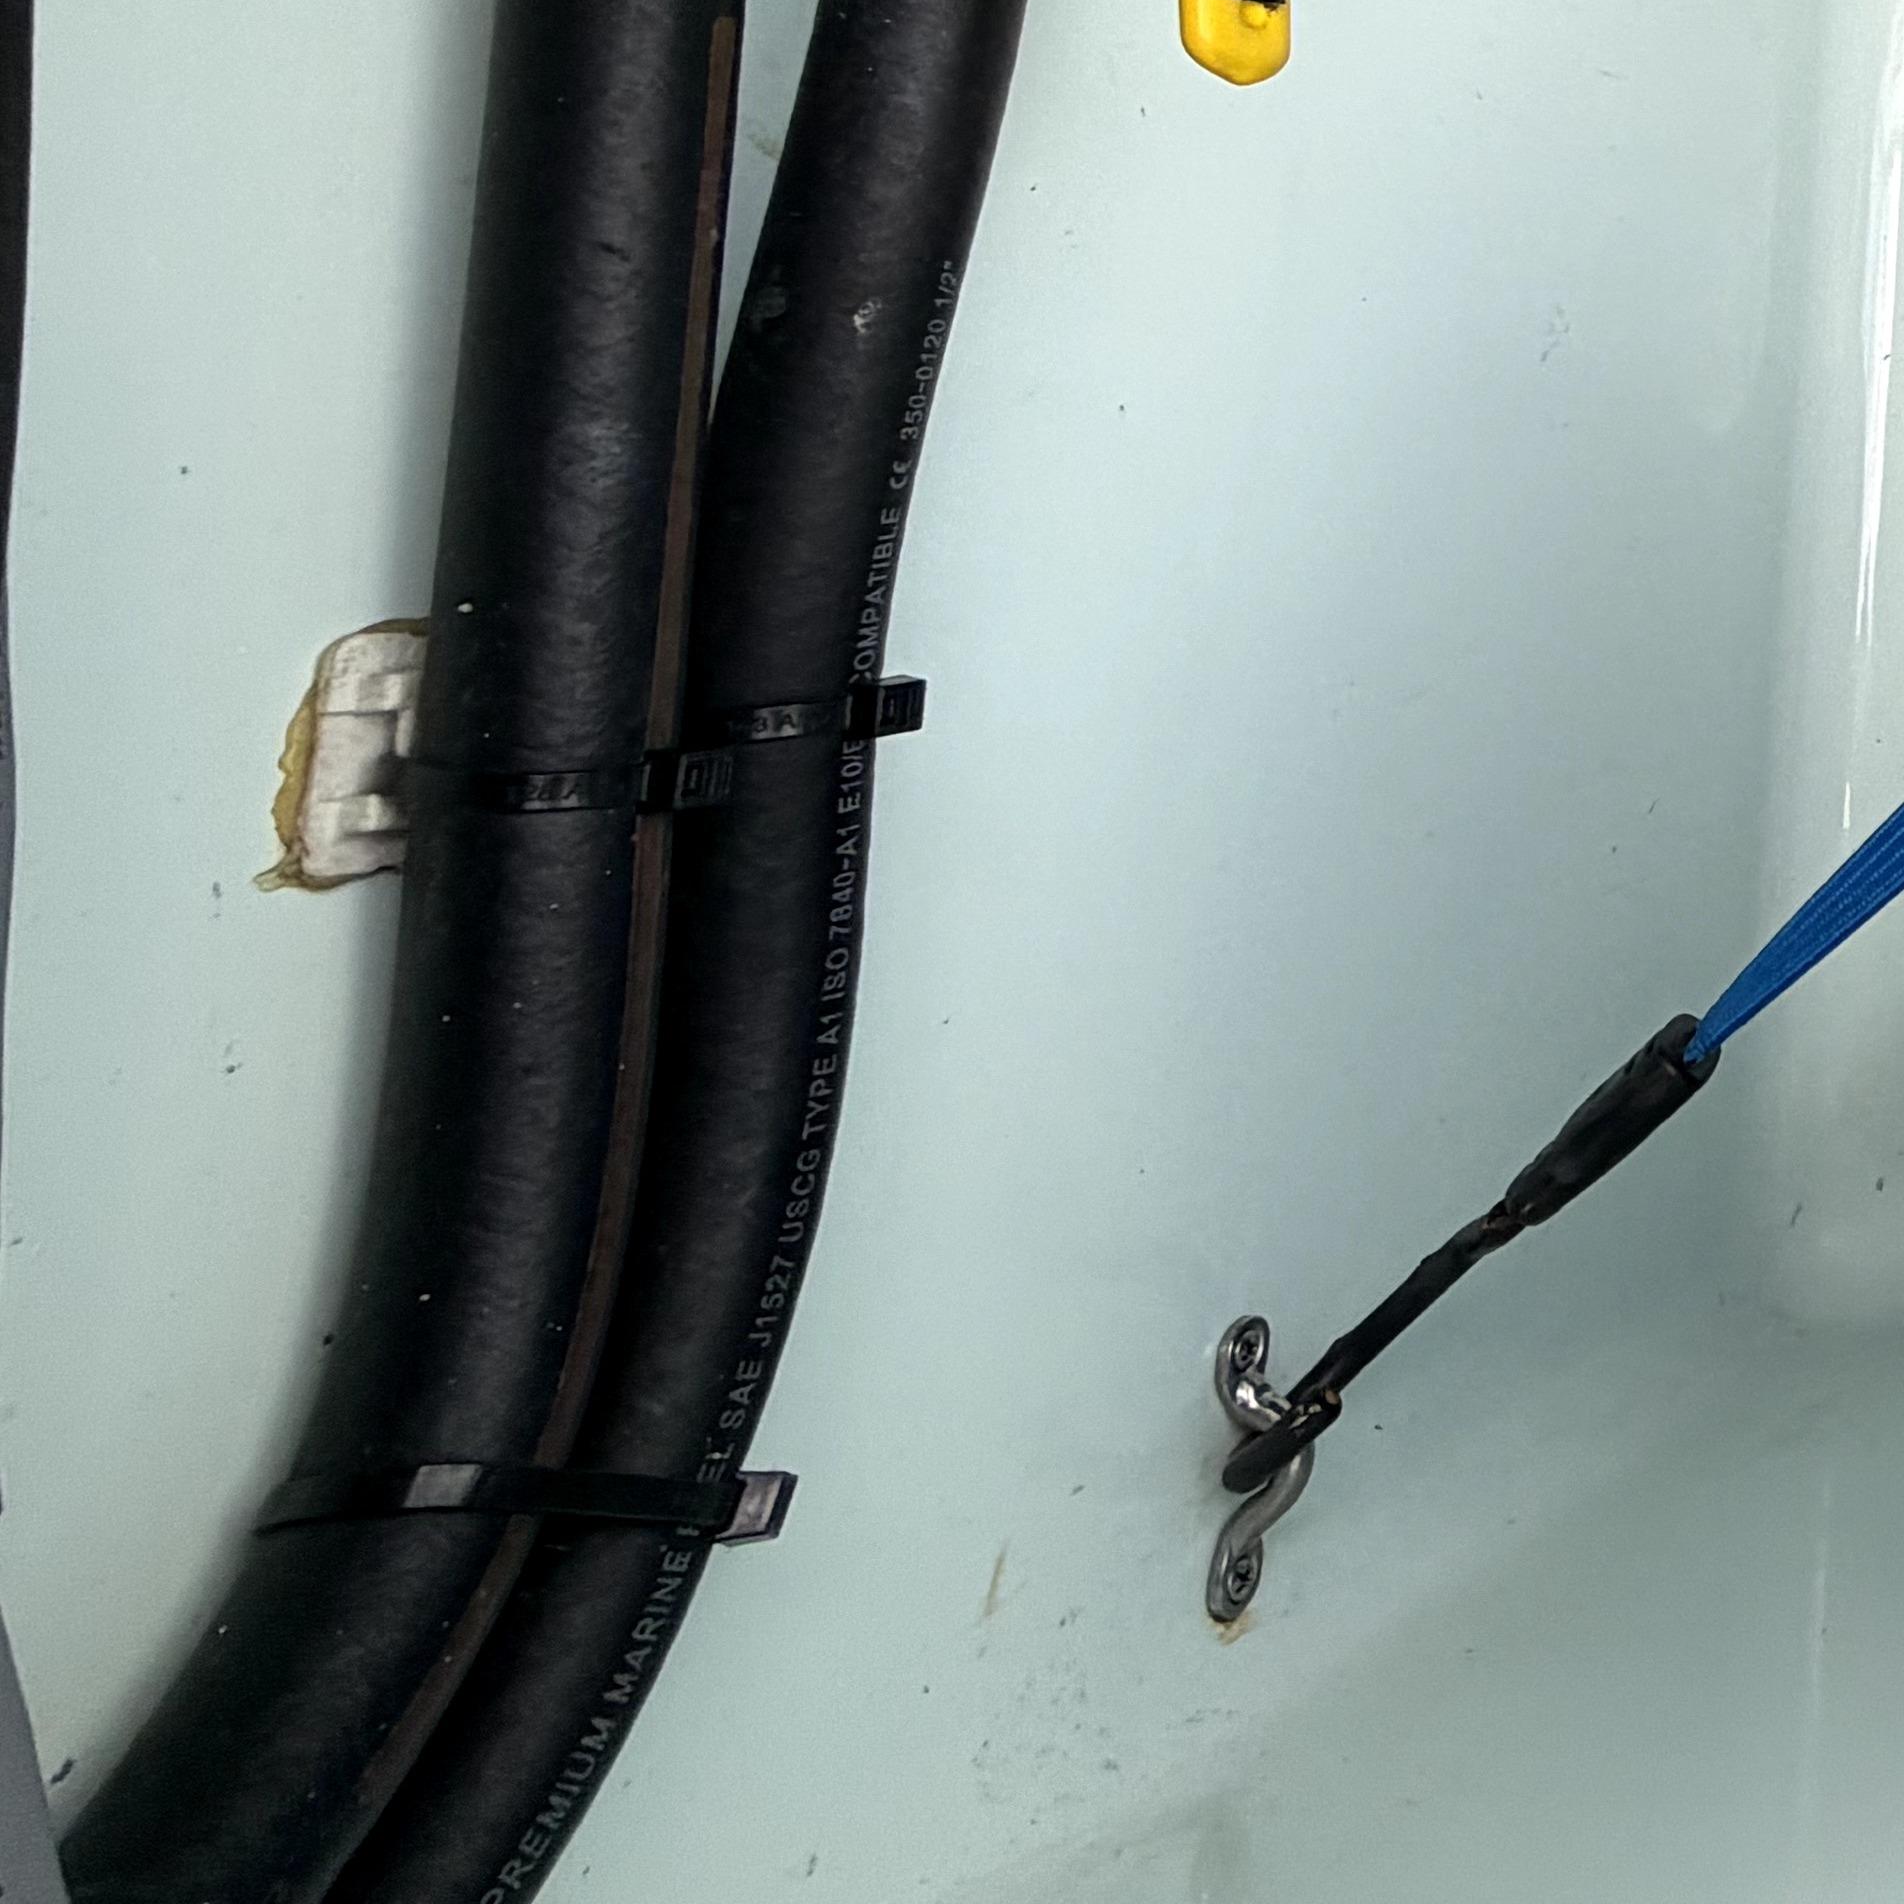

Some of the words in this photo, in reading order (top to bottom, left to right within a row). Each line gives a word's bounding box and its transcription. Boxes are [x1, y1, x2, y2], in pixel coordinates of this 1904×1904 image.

[900, 318, 946, 442] 350-0120
[829, 822, 863, 942] 7840-A1
[820, 946, 850, 1003] ISO
[816, 1008, 843, 1045] A1
[801, 1053, 838, 1142] TYPE
[777, 1148, 822, 1245] USCG
[748, 1255, 796, 1348] J1527
[719, 1360, 763, 1430] SAE
[602, 1541, 692, 1706] MARINE
